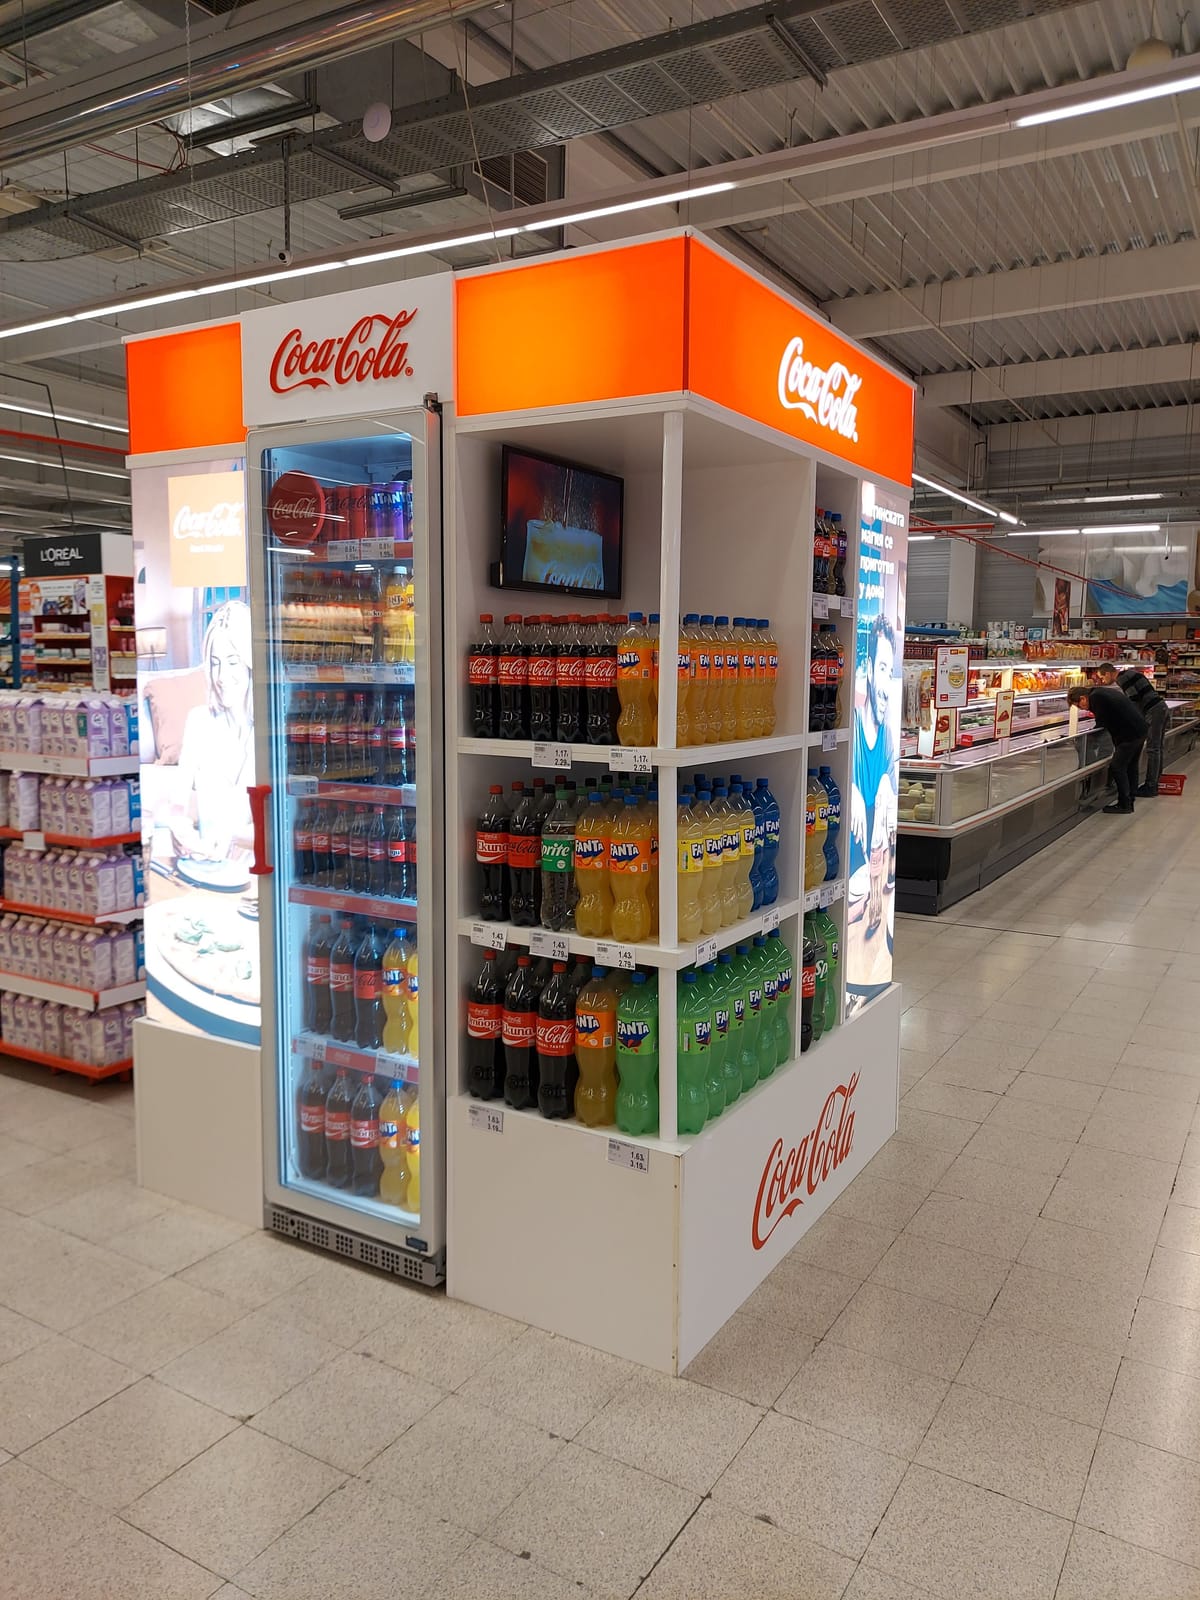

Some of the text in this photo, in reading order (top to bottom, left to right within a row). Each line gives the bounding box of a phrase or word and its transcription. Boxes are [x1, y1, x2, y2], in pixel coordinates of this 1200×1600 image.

[269, 308, 418, 394] Coca-Cola
[777, 336, 863, 443] Coca-Cola
[554, 758, 570, 766] 2.29
[633, 764, 650, 772] 2.29
[542, 842, 570, 857] prite
[576, 839, 604, 853] FANTA
[611, 843, 639, 857] FANTA
[552, 950, 568, 958] 2.79
[618, 960, 635, 968] 2.79
[617, 1020, 649, 1035] FANTA
[630, 1160, 646, 1170] 3.19
[752, 1067, 861, 1250] Coca-Cola
